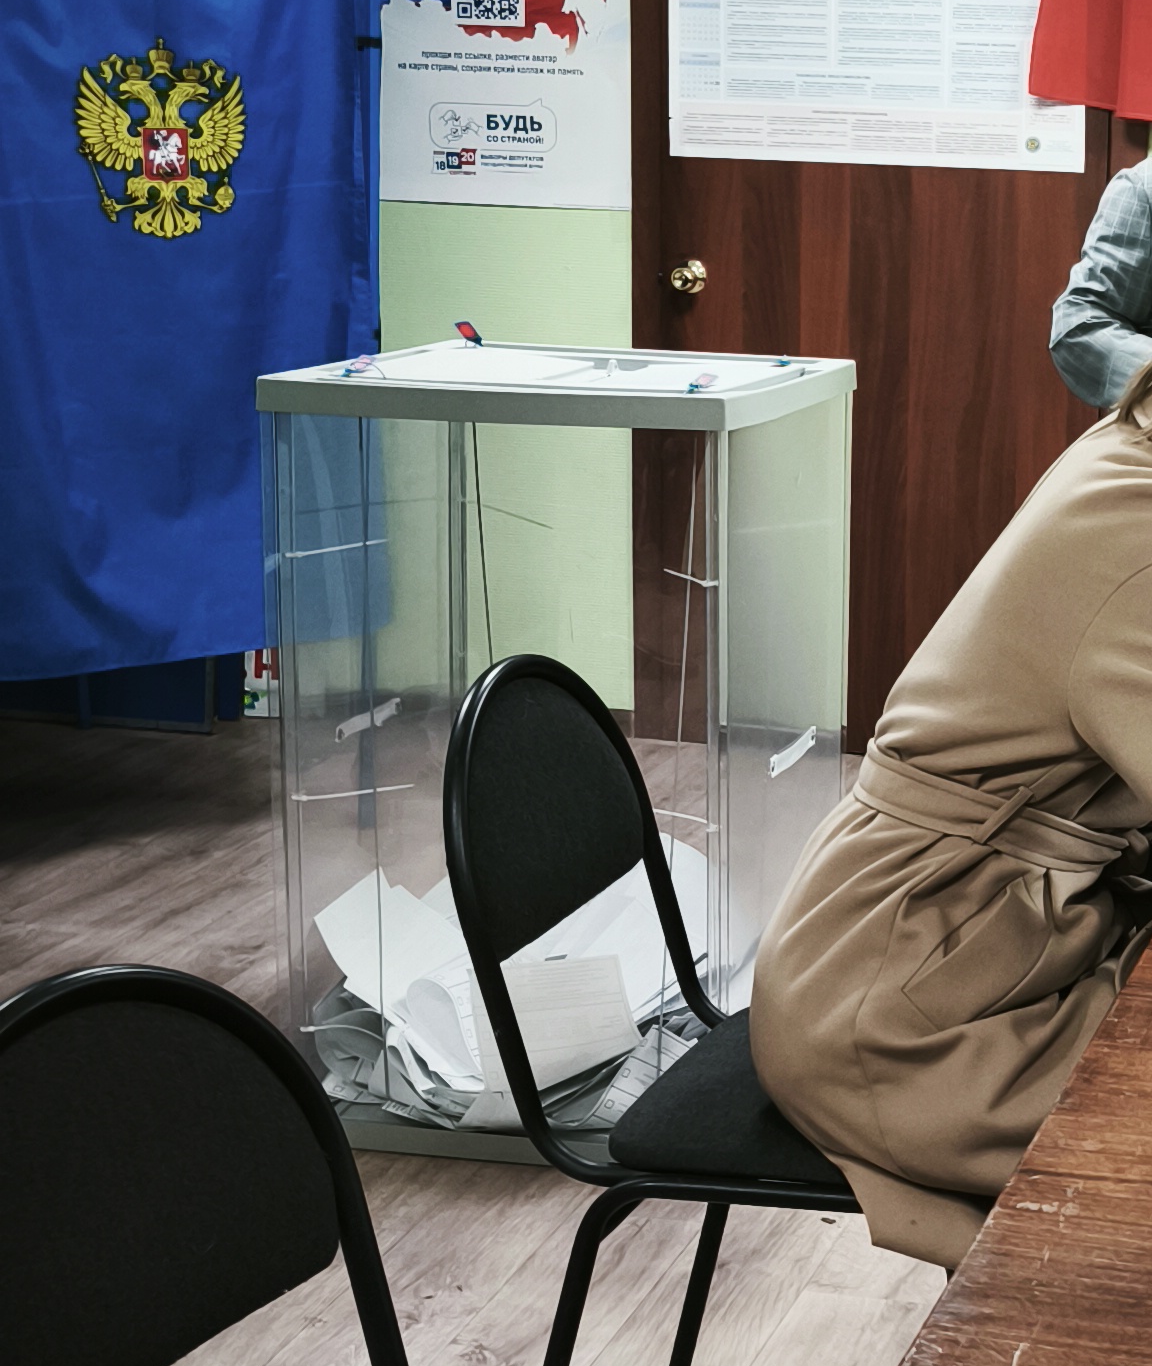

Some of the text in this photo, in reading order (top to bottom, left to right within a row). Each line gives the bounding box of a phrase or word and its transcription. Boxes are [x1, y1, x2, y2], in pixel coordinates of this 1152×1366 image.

[486, 113, 543, 135] БУДЬ
[486, 134, 544, 145] СО СТРАНОЙ!
[435, 150, 476, 171] 18 19 20
